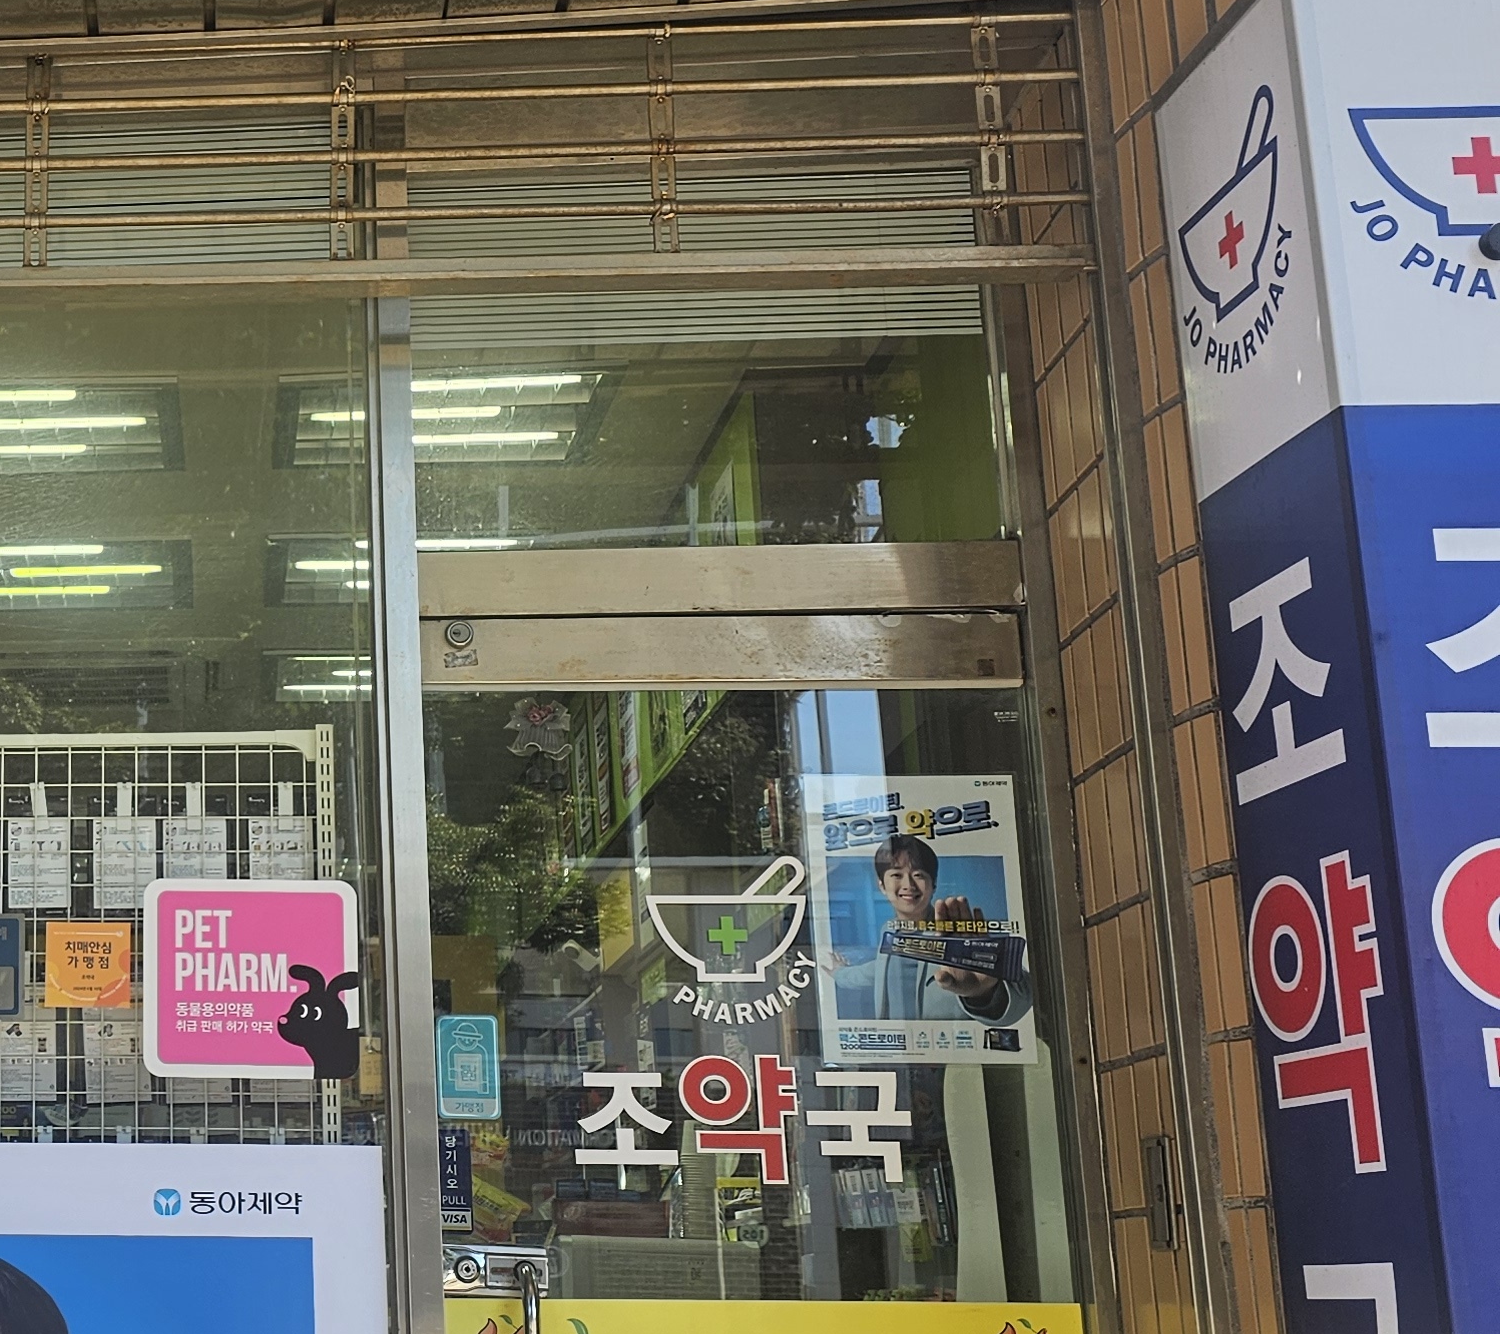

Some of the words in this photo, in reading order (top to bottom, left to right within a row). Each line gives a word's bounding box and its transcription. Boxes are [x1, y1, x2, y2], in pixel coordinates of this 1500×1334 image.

[1350, 199, 1399, 241] JO
[1183, 305, 1203, 348] JO
[1204, 222, 1293, 374] PHARMACY
[174, 909, 233, 949] PET
[64, 941, 113, 955] 치매안심
[174, 951, 298, 993] PHARM.
[672, 951, 817, 1025] PHARMACY
[175, 1002, 254, 1018] 동물용의약품
[176, 1020, 198, 1033] 취급
[201, 1020, 223, 1033] 판매
[226, 1021, 249, 1034] 허가
[251, 1021, 274, 1034] 약국
[454, 1101, 485, 1114] 가맹점
[574, 1054, 913, 1185] 조약국
[444, 1136, 459, 1190] 당기시오
[188, 1191, 304, 1216] 동아제약
[442, 1195, 467, 1206] PULL
[441, 1213, 468, 1225] VISA
